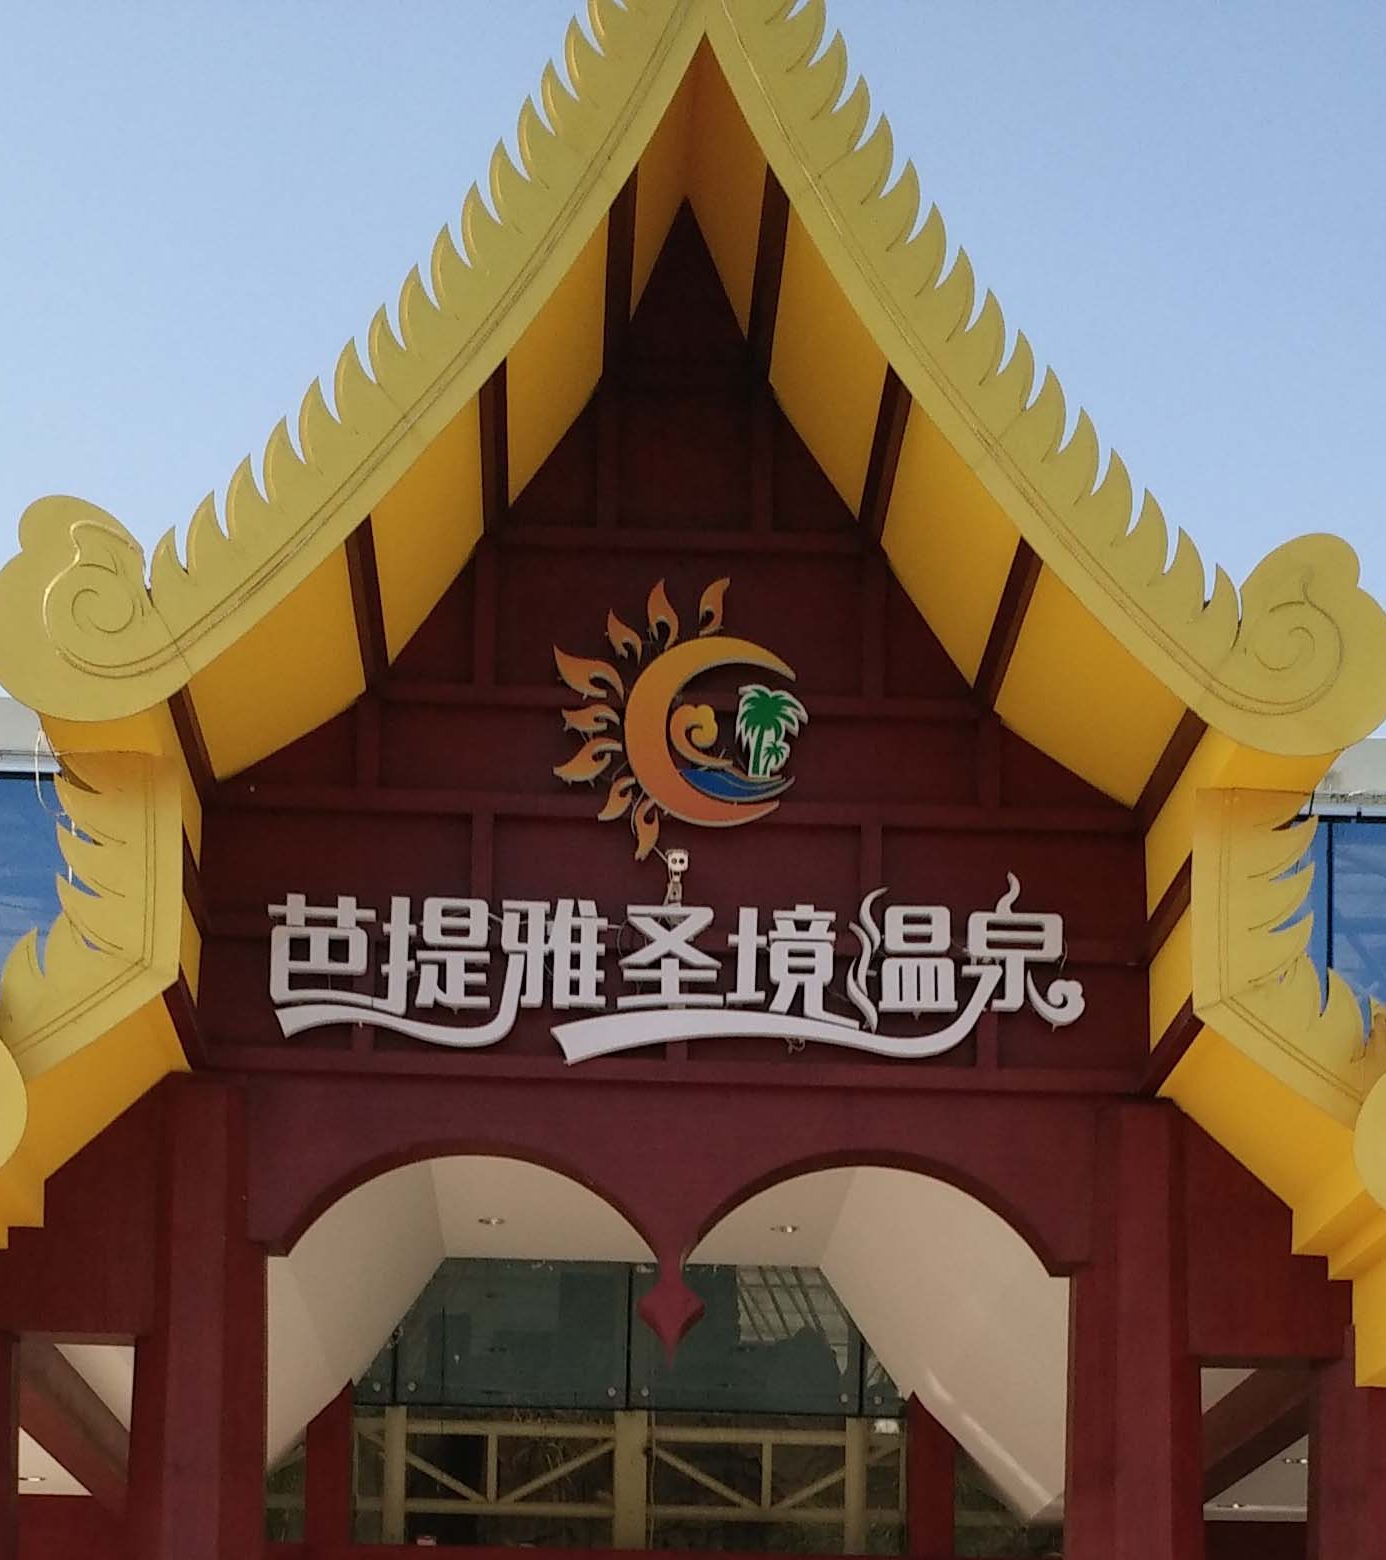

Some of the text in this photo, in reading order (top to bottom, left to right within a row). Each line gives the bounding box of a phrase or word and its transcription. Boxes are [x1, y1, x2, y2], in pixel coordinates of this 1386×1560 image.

[267, 872, 1086, 1064] 芭提雅圣境温泉
